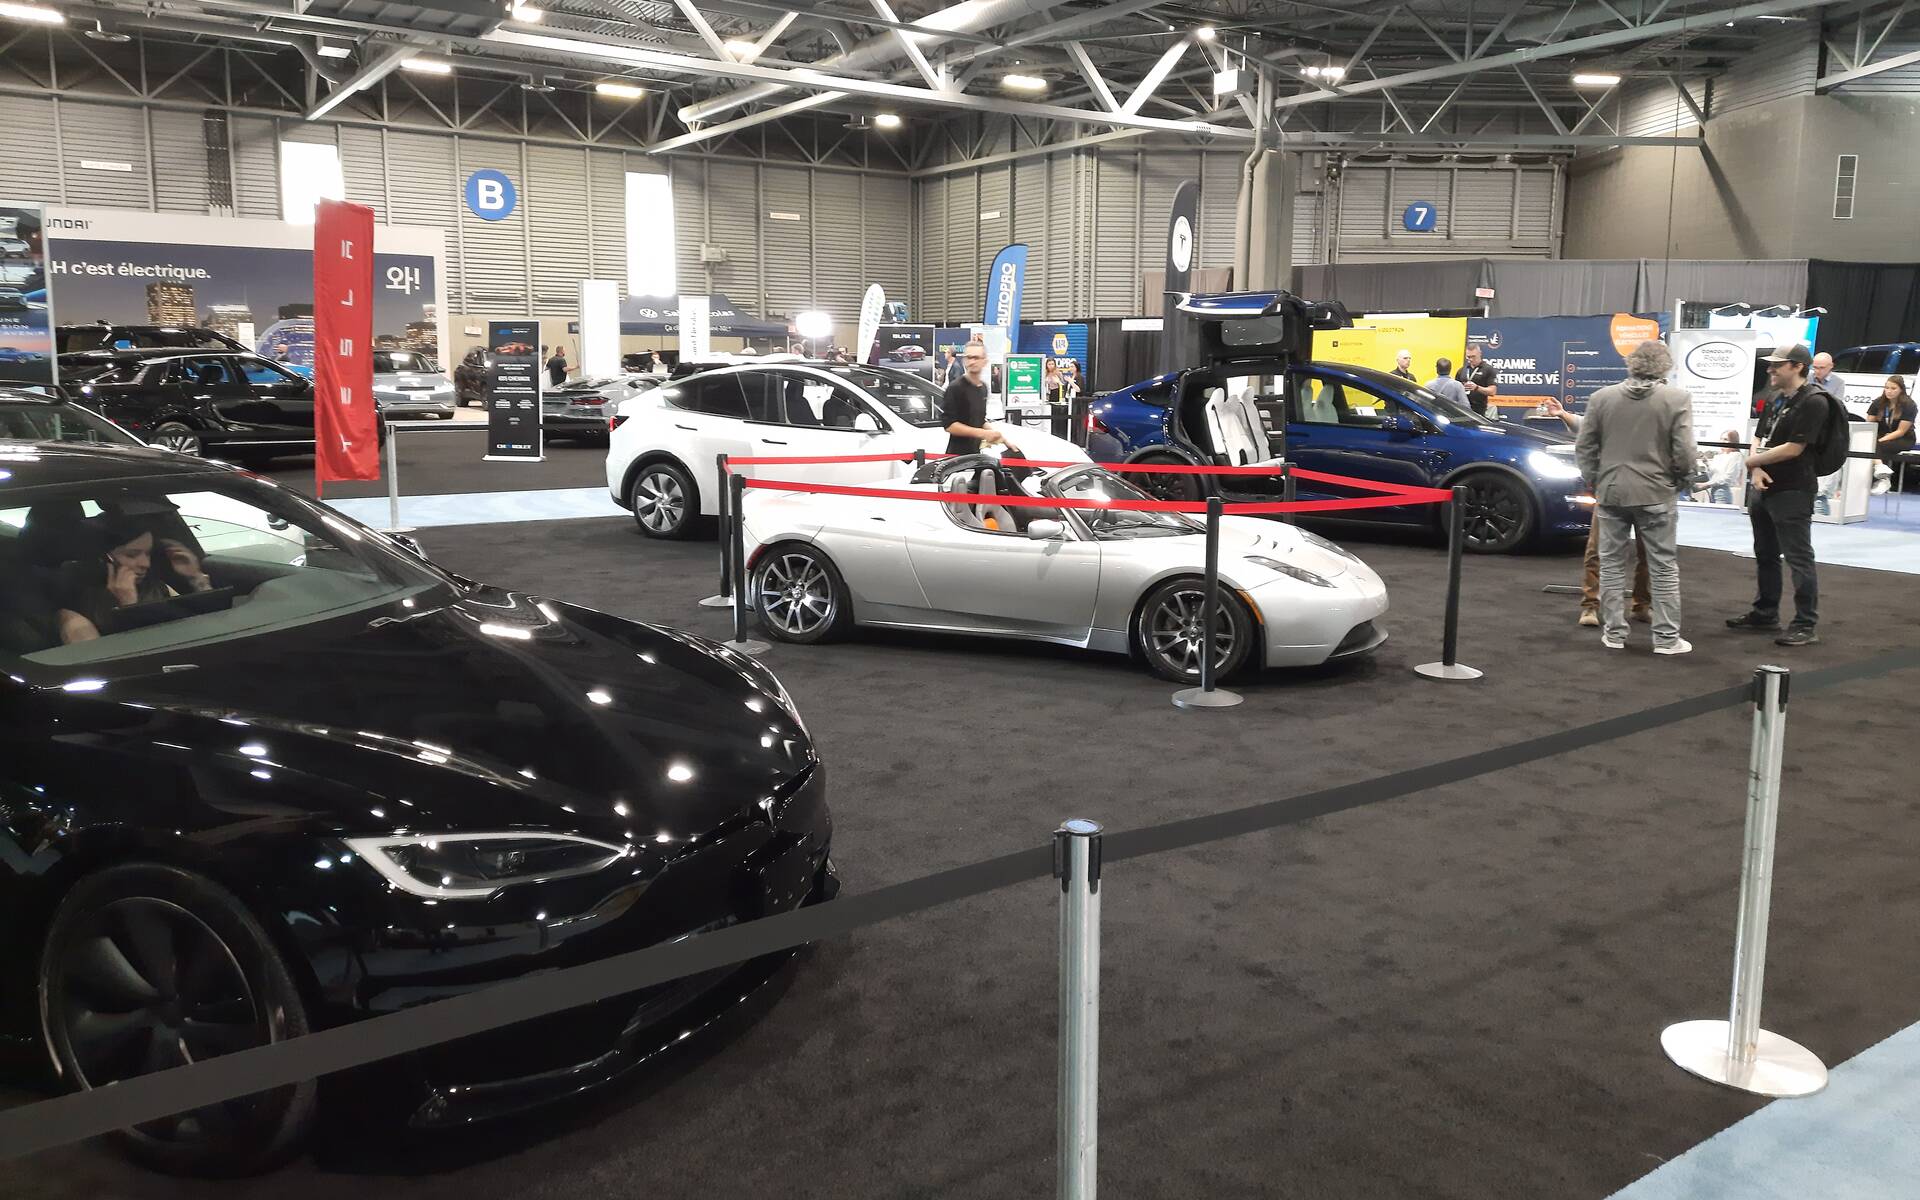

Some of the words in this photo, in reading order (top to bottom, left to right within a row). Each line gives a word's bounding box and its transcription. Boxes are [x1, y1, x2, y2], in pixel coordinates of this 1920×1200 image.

[478, 179, 504, 210] B
[1415, 207, 1428, 225] 7
[70, 261, 114, 276] c'est
[117, 262, 211, 281] électrique.
[386, 266, 420, 295] 와!
[996, 262, 1013, 326] AUTOPRO
[339, 240, 353, 452] TESLA
[1495, 370, 1543, 384] ÉTENCES
[1545, 370, 1560, 384] VÉ
